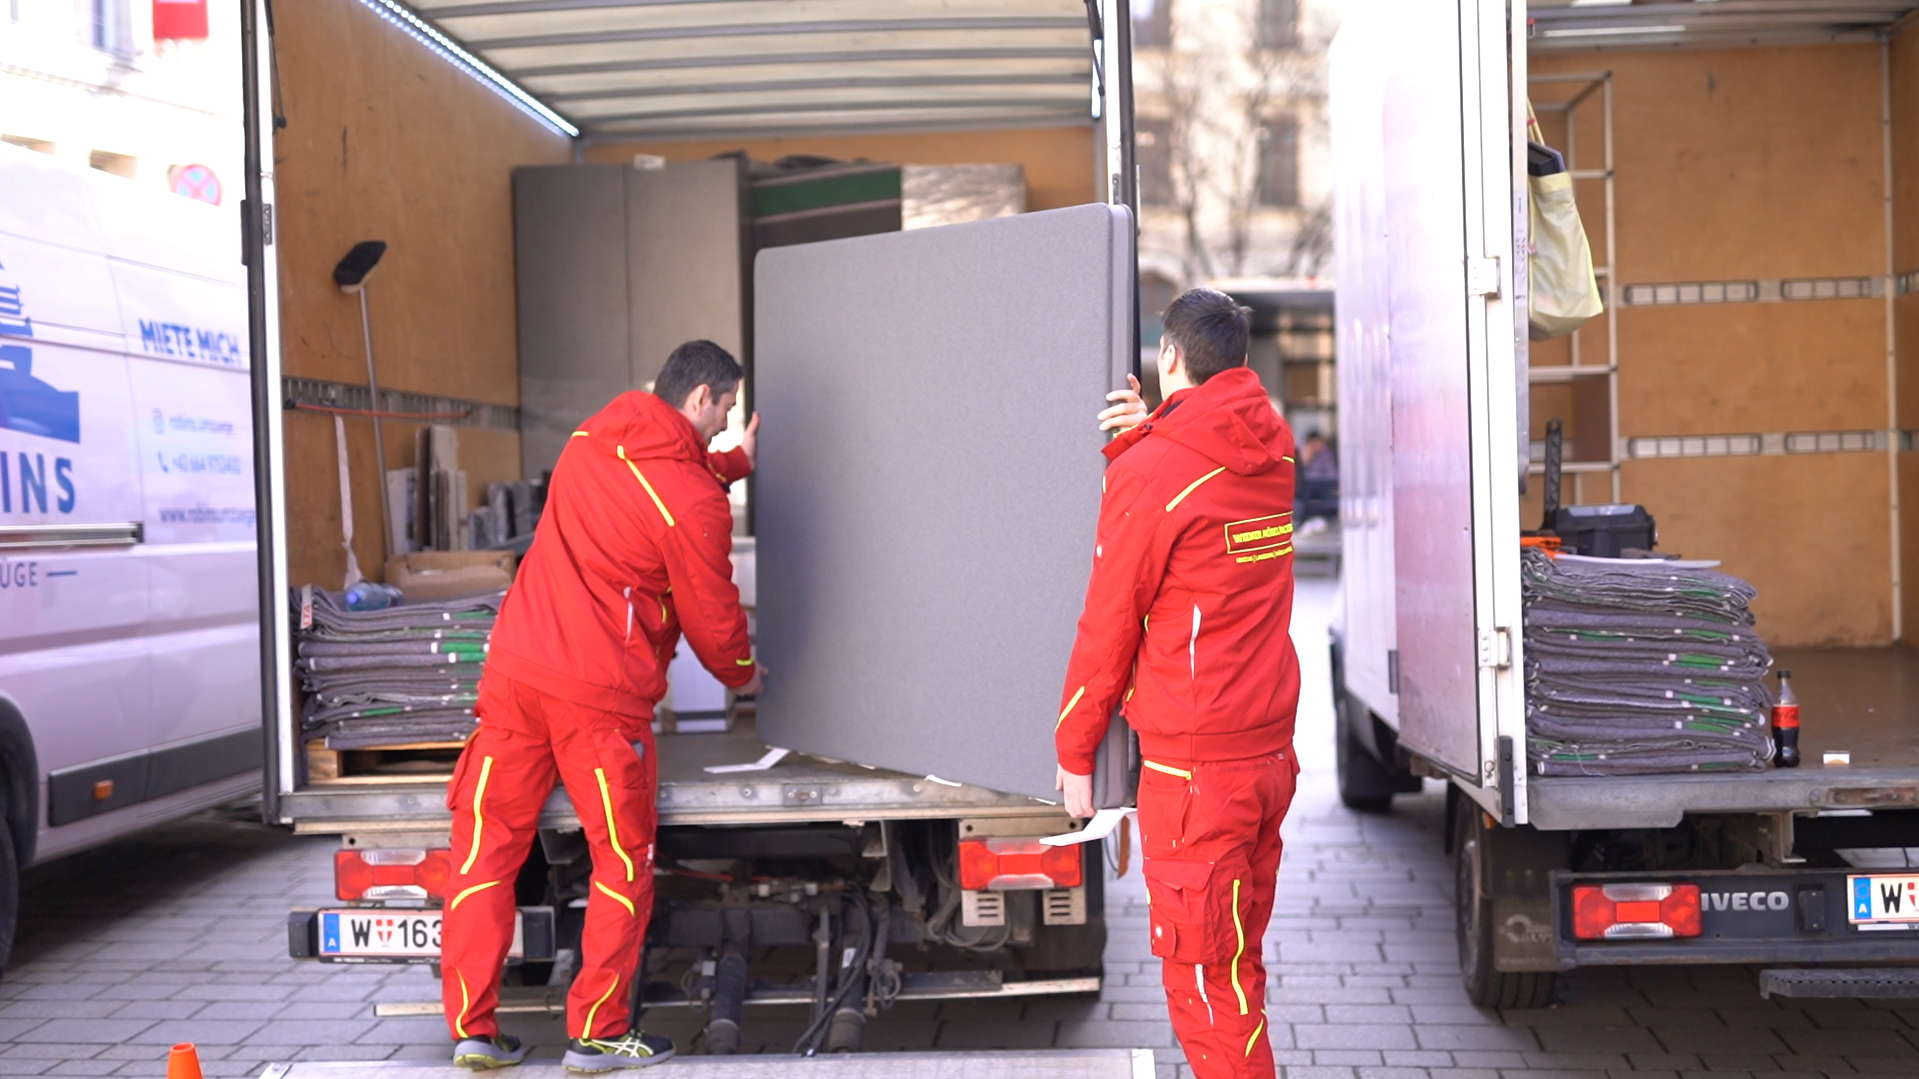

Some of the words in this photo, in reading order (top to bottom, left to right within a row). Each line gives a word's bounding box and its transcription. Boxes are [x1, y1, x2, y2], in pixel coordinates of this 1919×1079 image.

[138, 318, 196, 358] MIETE
[196, 328, 242, 364] MICH
[0, 451, 76, 514] INS
[1701, 890, 1790, 911] IVECO
[1858, 903, 1868, 914] A
[1880, 882, 1902, 914] W
[351, 918, 372, 948] W
[397, 918, 442, 949] 163
